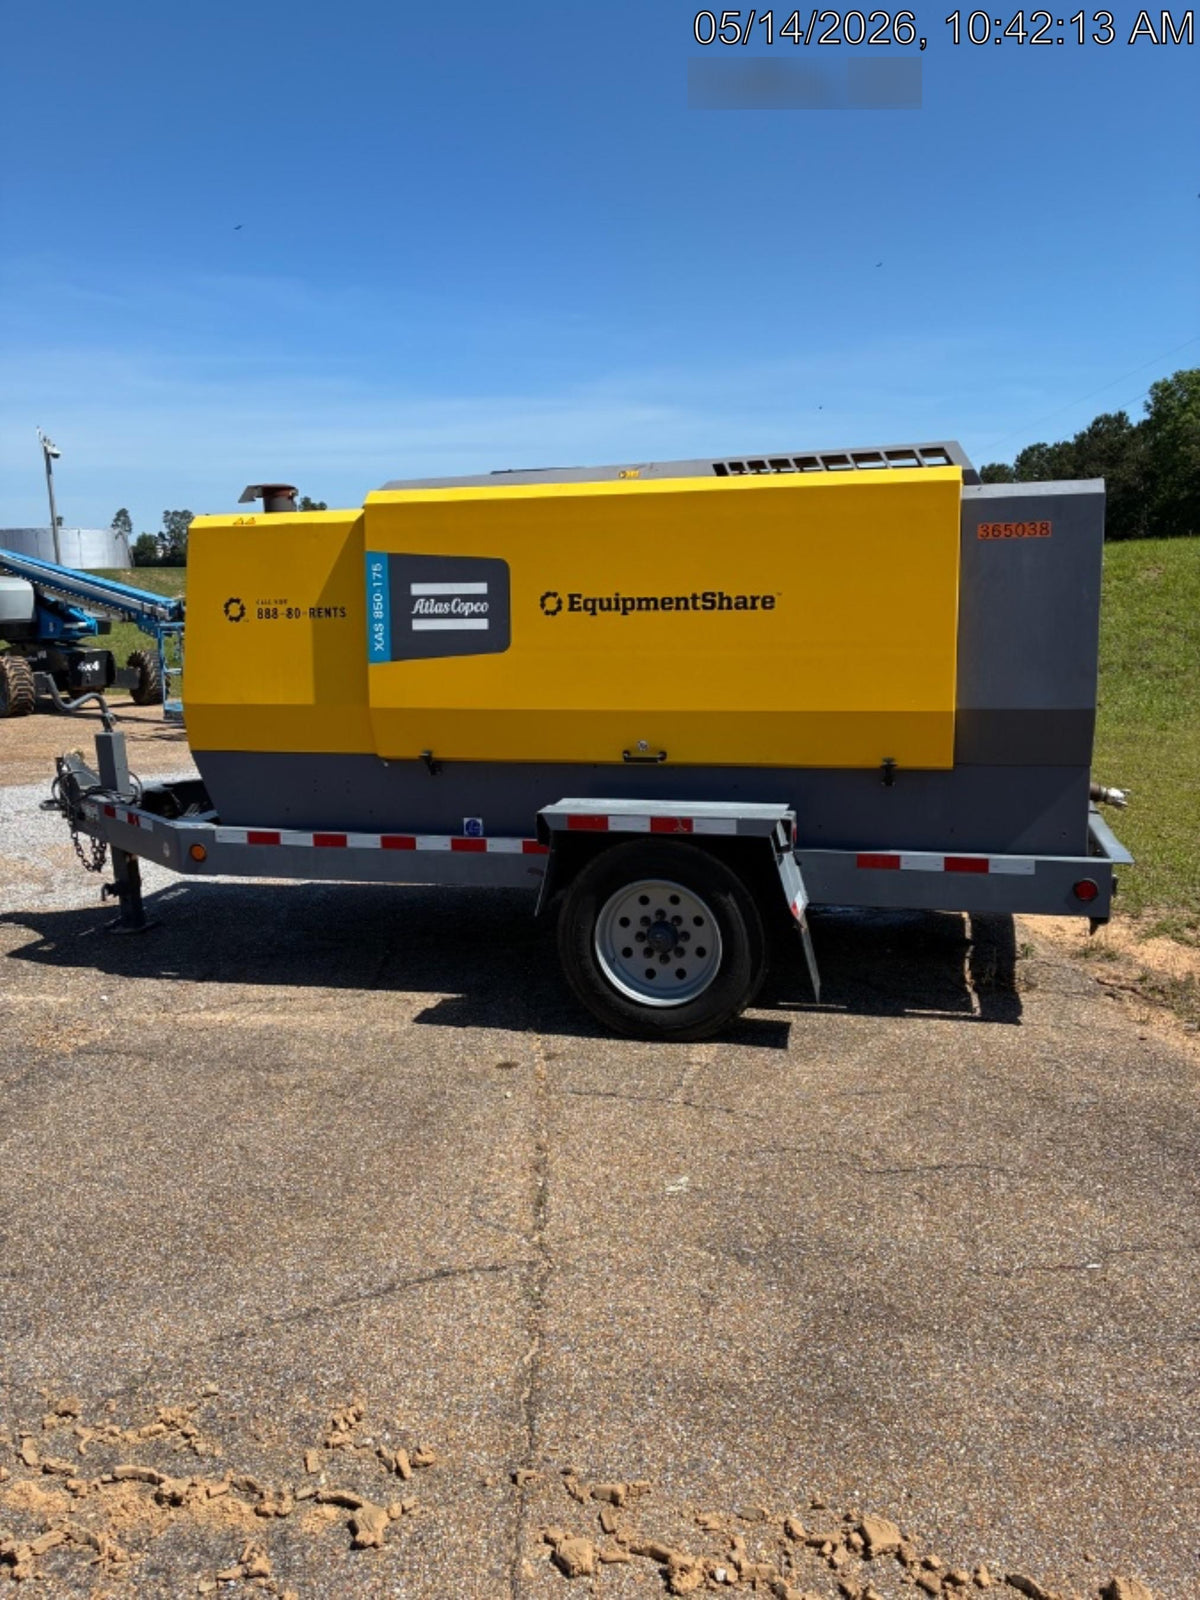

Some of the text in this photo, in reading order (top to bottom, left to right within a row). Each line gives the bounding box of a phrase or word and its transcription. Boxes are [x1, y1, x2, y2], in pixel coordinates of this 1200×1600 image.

[979, 521, 1050, 538] 365038
[257, 607, 346, 619] 888-80-RENTS
[372, 562, 385, 652] XAS 850-175
[567, 591, 776, 616] EquipmentShare
